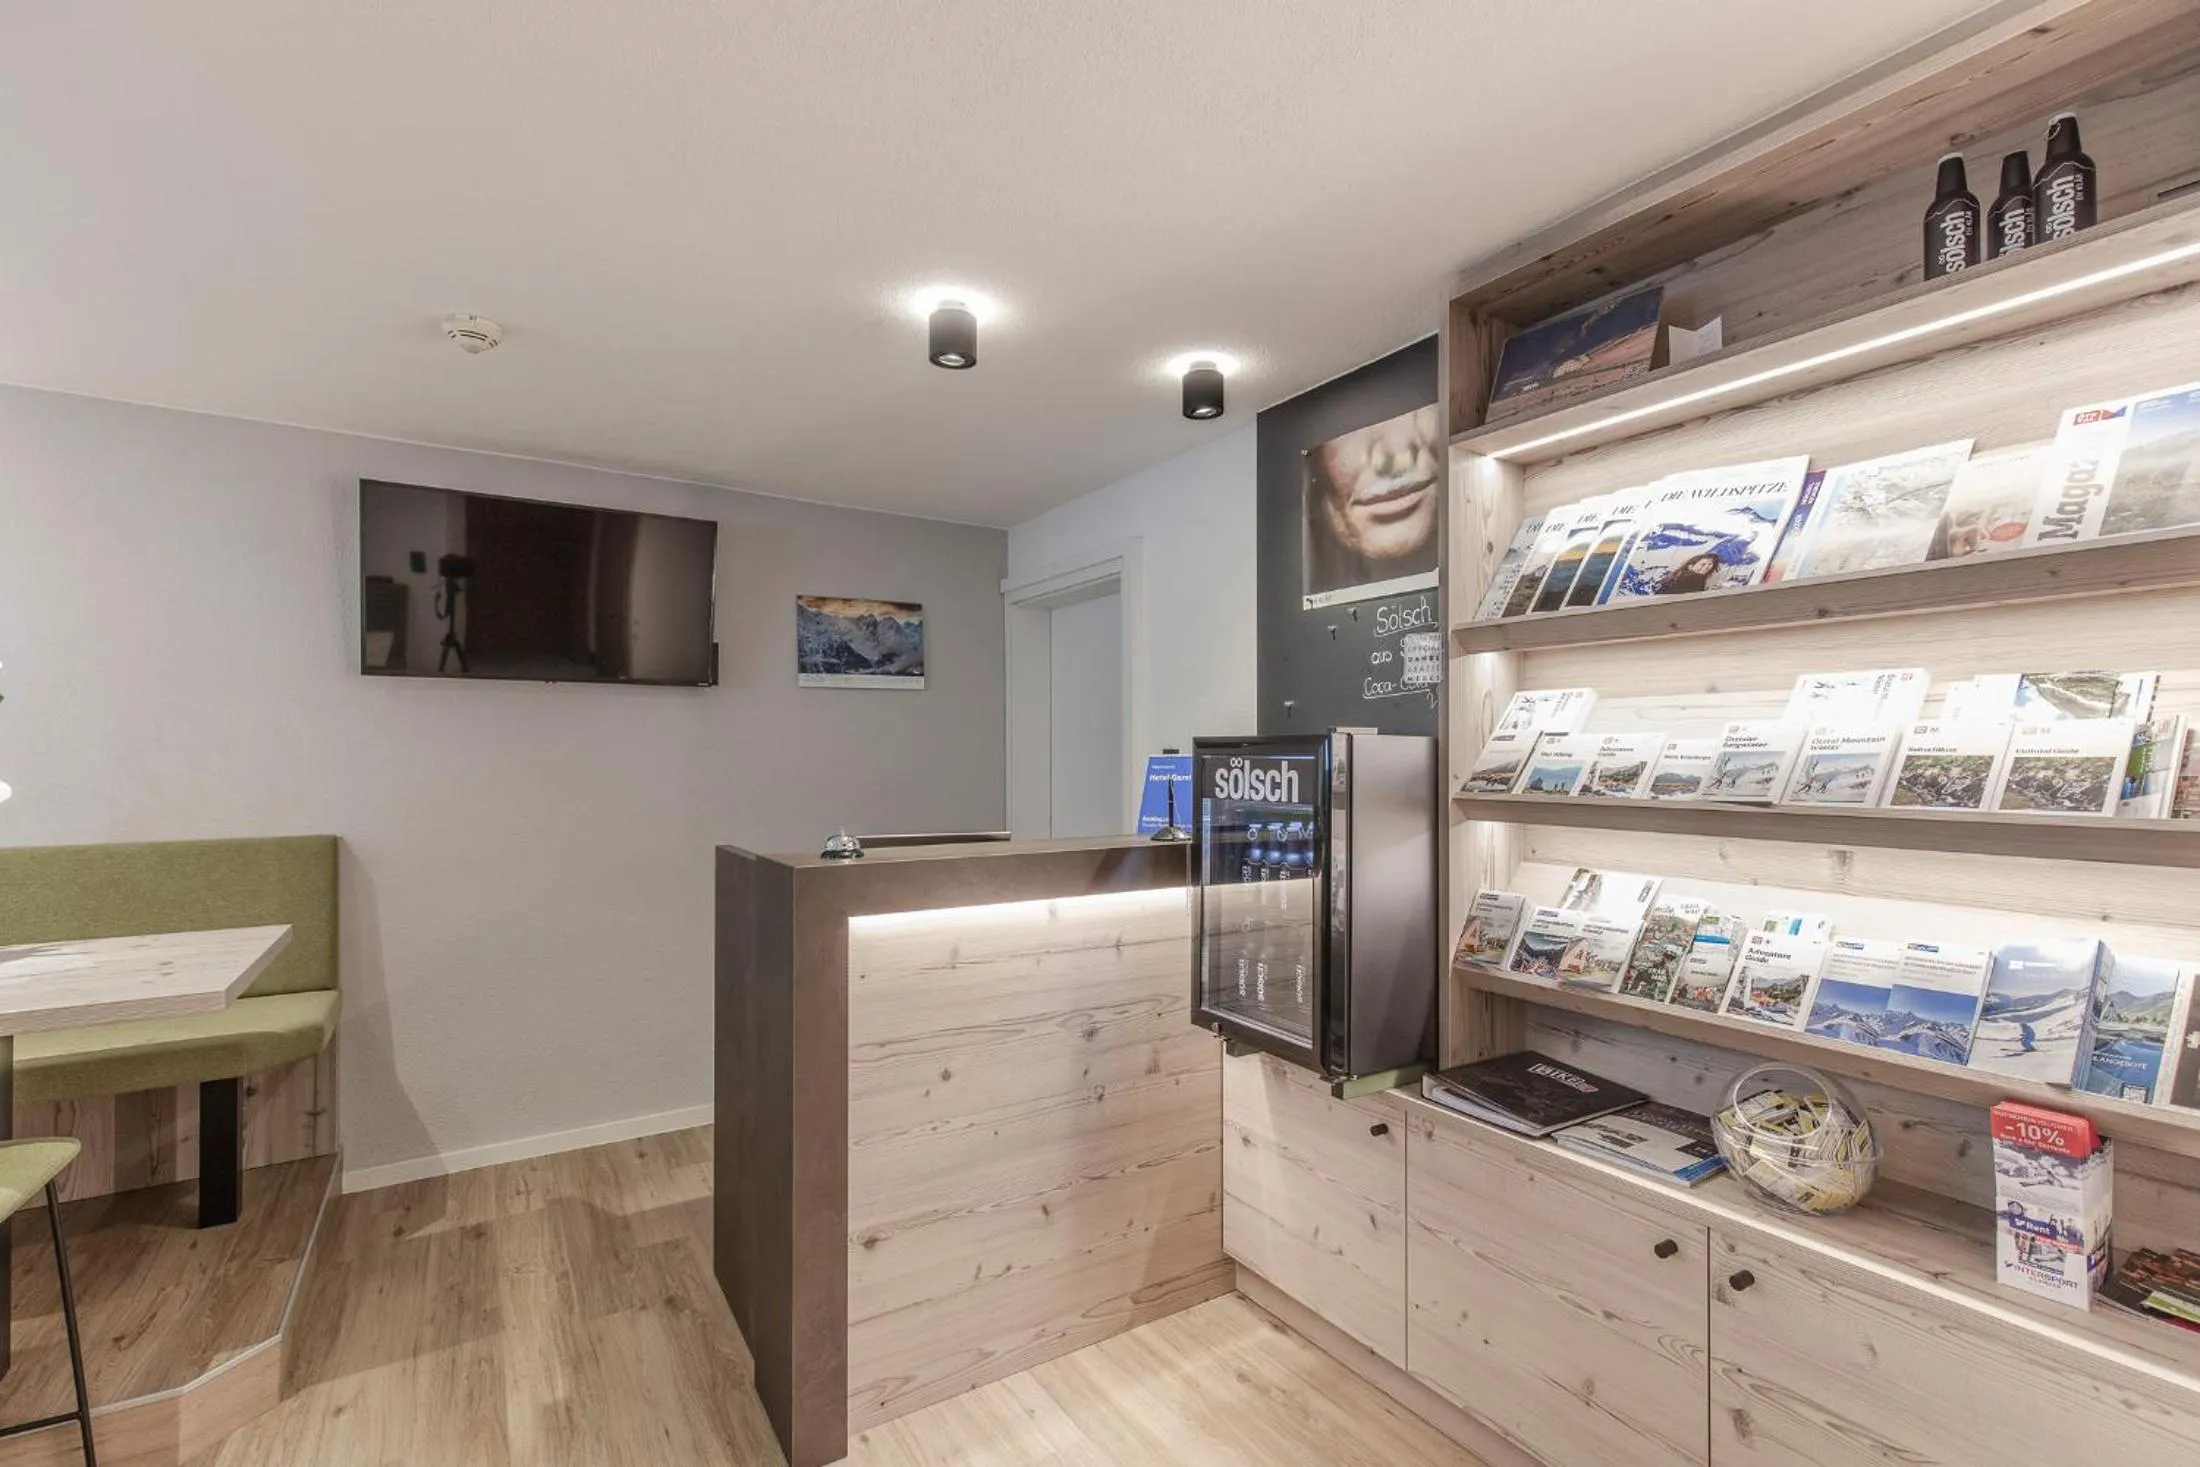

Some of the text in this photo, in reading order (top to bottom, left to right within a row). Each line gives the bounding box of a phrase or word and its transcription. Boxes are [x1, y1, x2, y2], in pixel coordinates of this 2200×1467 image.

[1999, 208, 2025, 255] lsch
[1215, 757, 1299, 803] sölsch
[1745, 955, 1770, 964] Guide
[1748, 948, 1792, 960] Adventure
